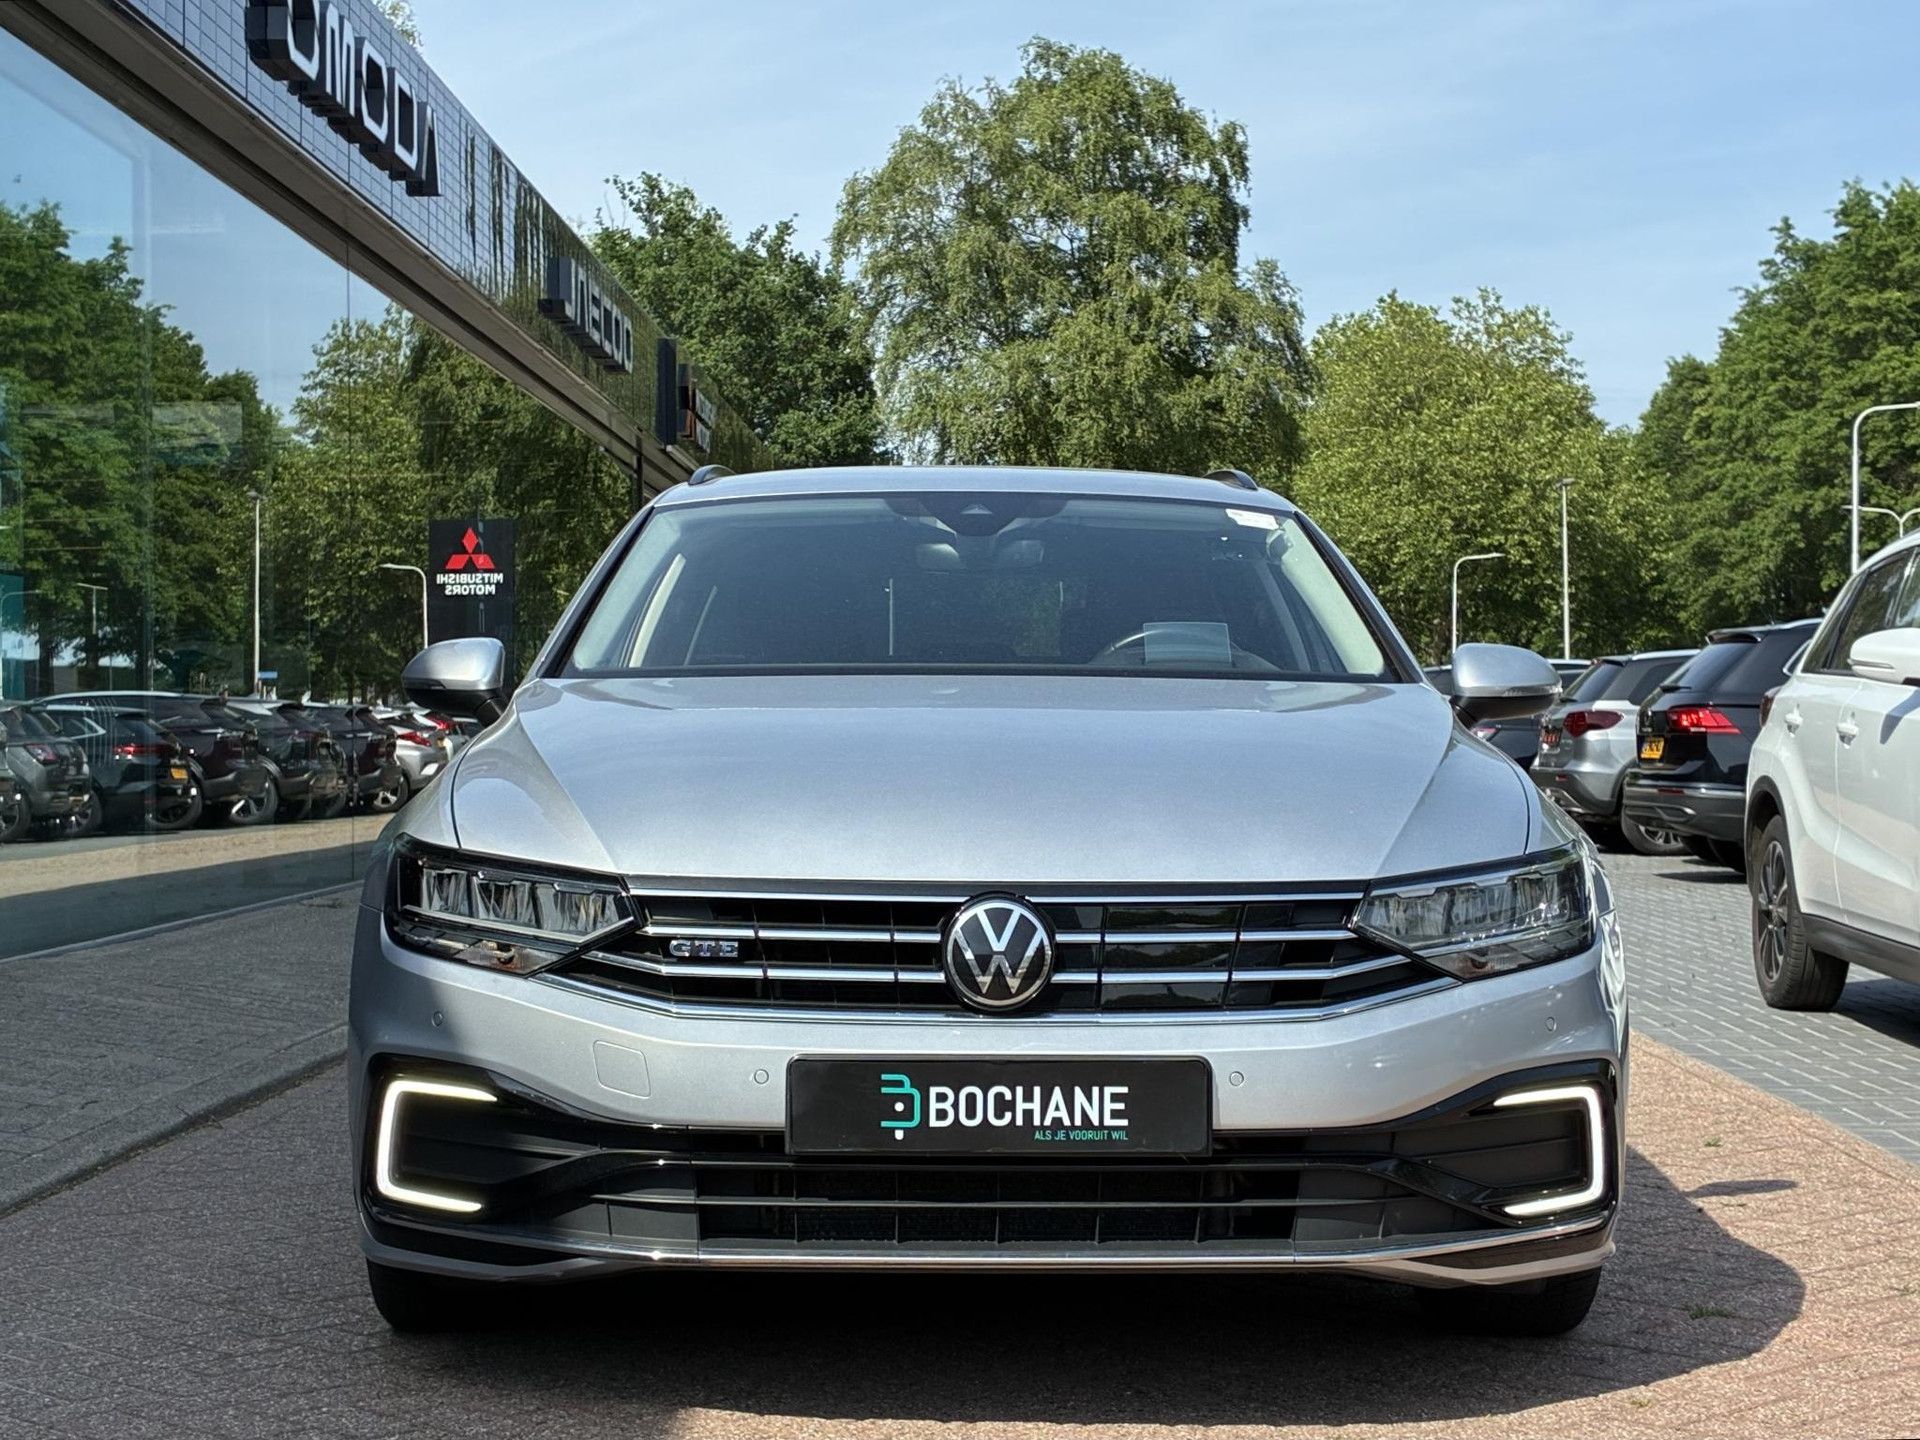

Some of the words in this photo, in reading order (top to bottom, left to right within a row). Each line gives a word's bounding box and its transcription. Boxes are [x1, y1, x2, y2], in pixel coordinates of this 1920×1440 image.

[669, 939, 739, 958] GTE
[928, 1085, 1130, 1128] BOCHANE
[1034, 1129, 1053, 1141] ALS
[1055, 1129, 1067, 1141] JE
[1068, 1129, 1109, 1141] VOORUIT
[1110, 1129, 1129, 1141] WIL
